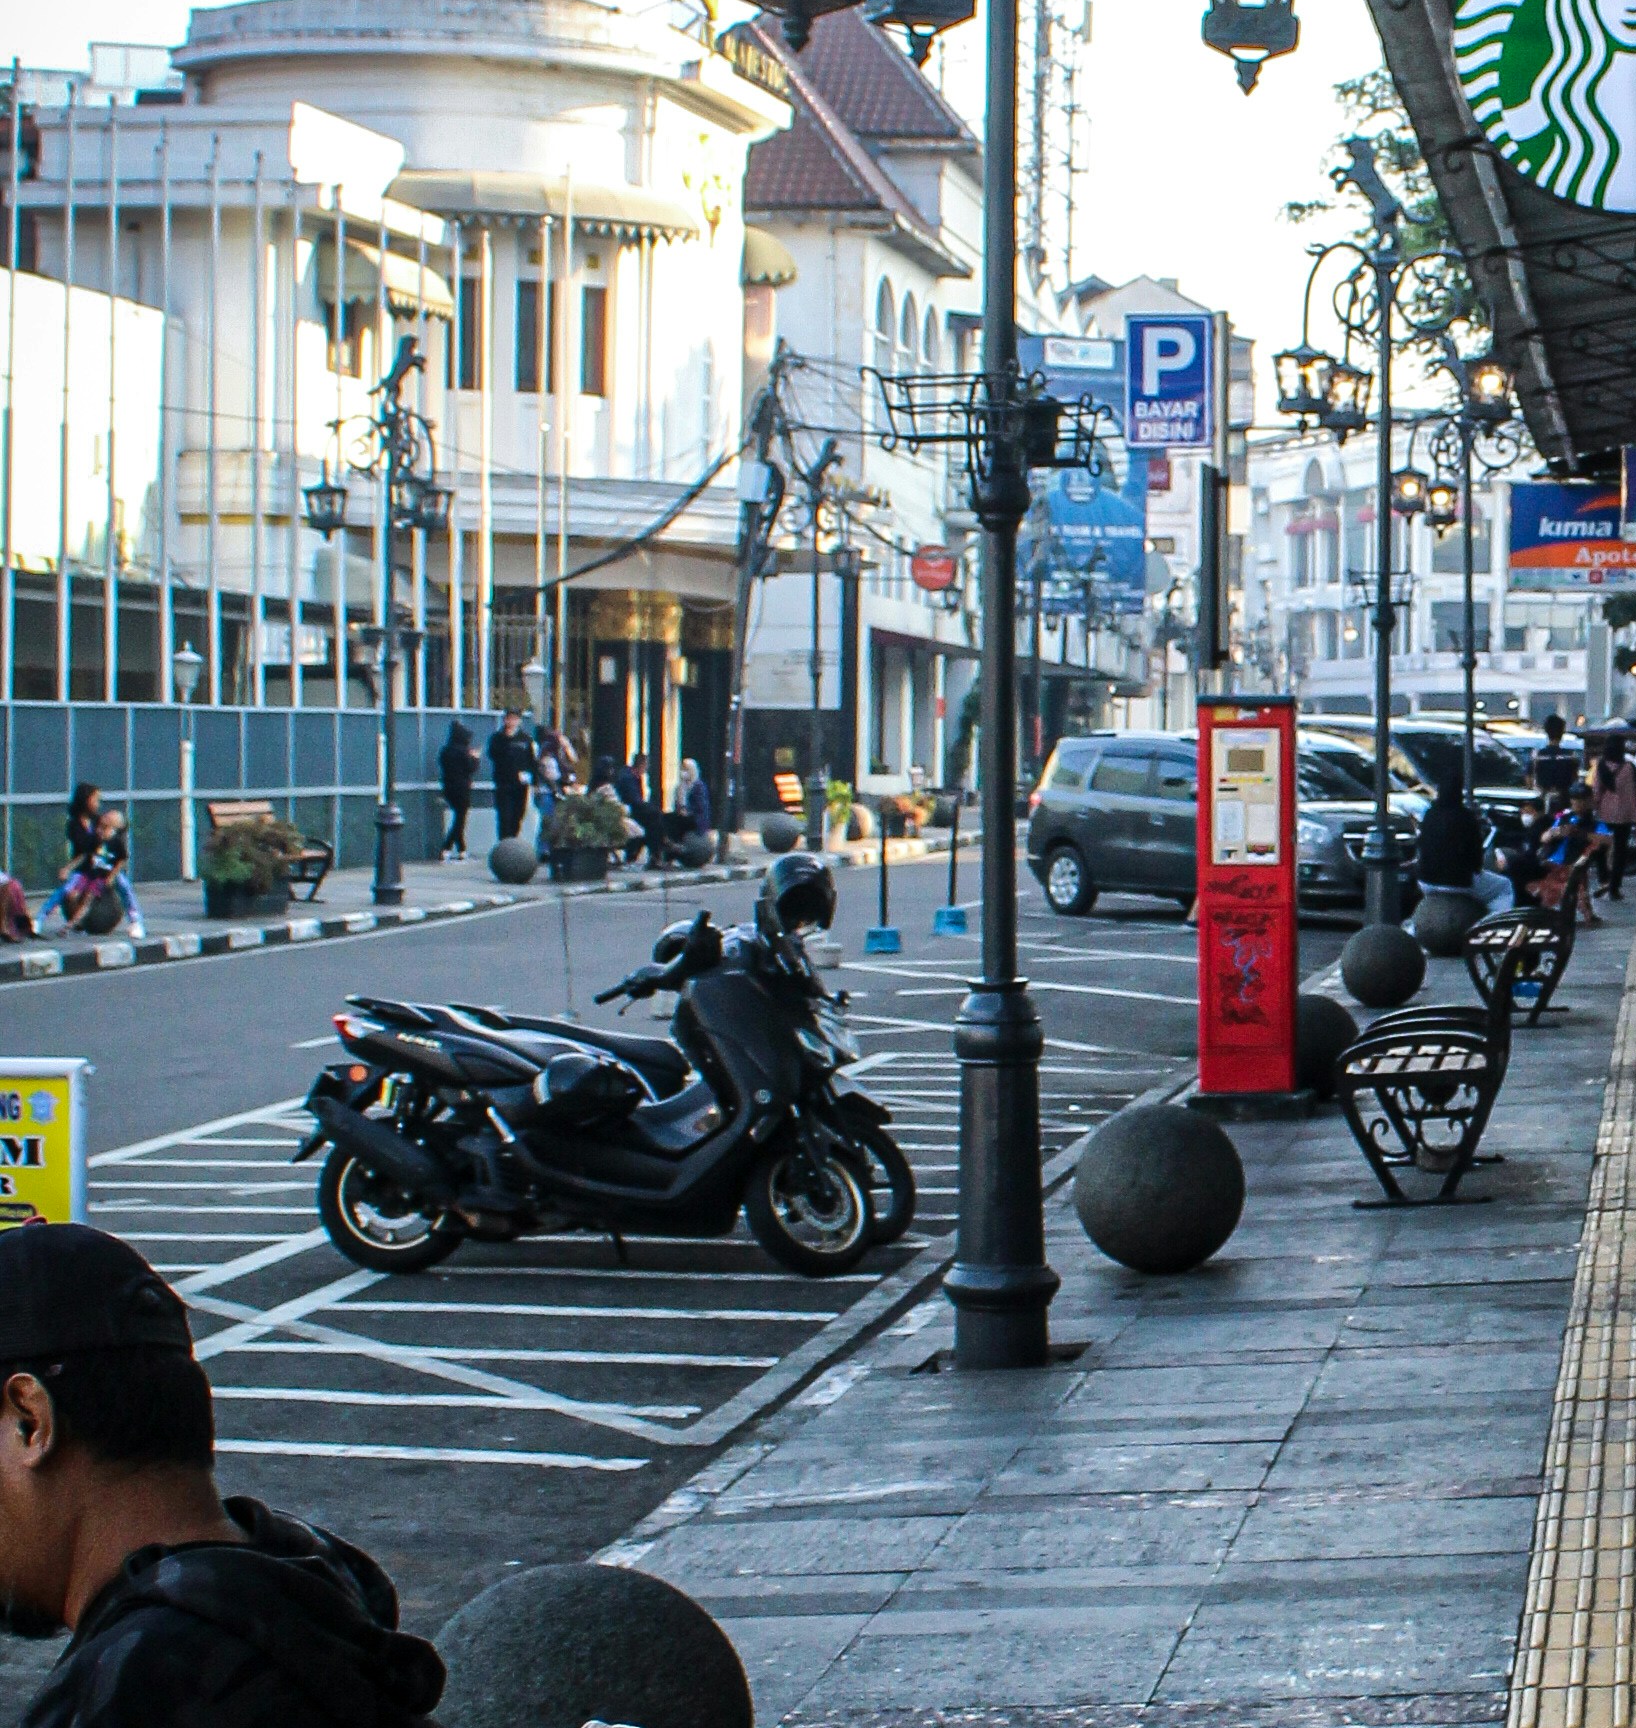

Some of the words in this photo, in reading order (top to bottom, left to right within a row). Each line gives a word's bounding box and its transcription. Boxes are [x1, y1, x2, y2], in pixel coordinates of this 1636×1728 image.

[1142, 326, 1197, 396] P
[1134, 401, 1198, 419] BAYAR
[1138, 421, 1196, 441] DISINI
[1540, 516, 1612, 538] kimia
